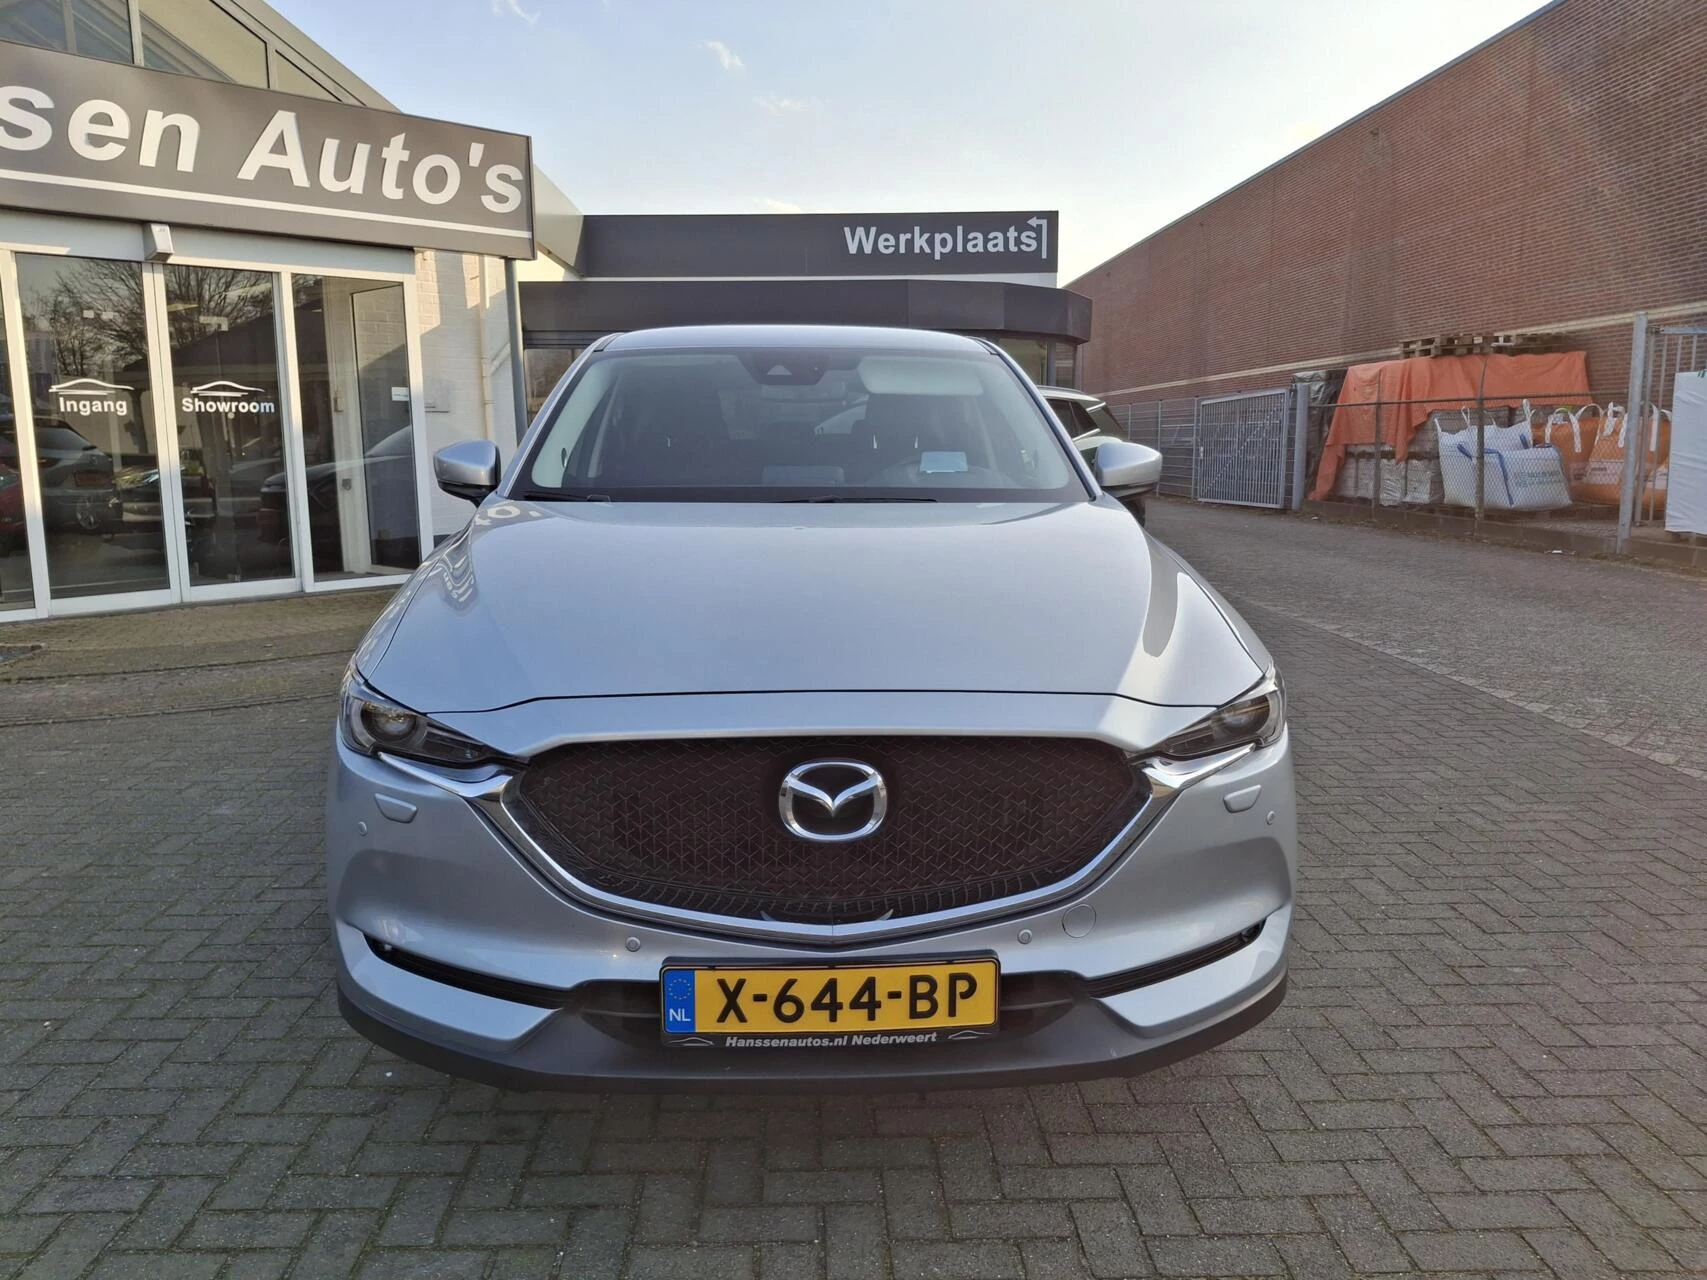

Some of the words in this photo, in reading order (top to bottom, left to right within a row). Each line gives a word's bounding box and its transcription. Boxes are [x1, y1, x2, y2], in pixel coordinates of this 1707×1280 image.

[236, 109, 524, 213] Auto's
[843, 224, 1038, 260] Werkplaats
[59, 397, 128, 416] Ingang
[181, 397, 275, 413] Showroom
[716, 972, 978, 1024] X-644-BP
[669, 1008, 691, 1022] NL
[725, 1034, 849, 1048] Hanssenautos.nl
[851, 1031, 938, 1046] Nederweert
